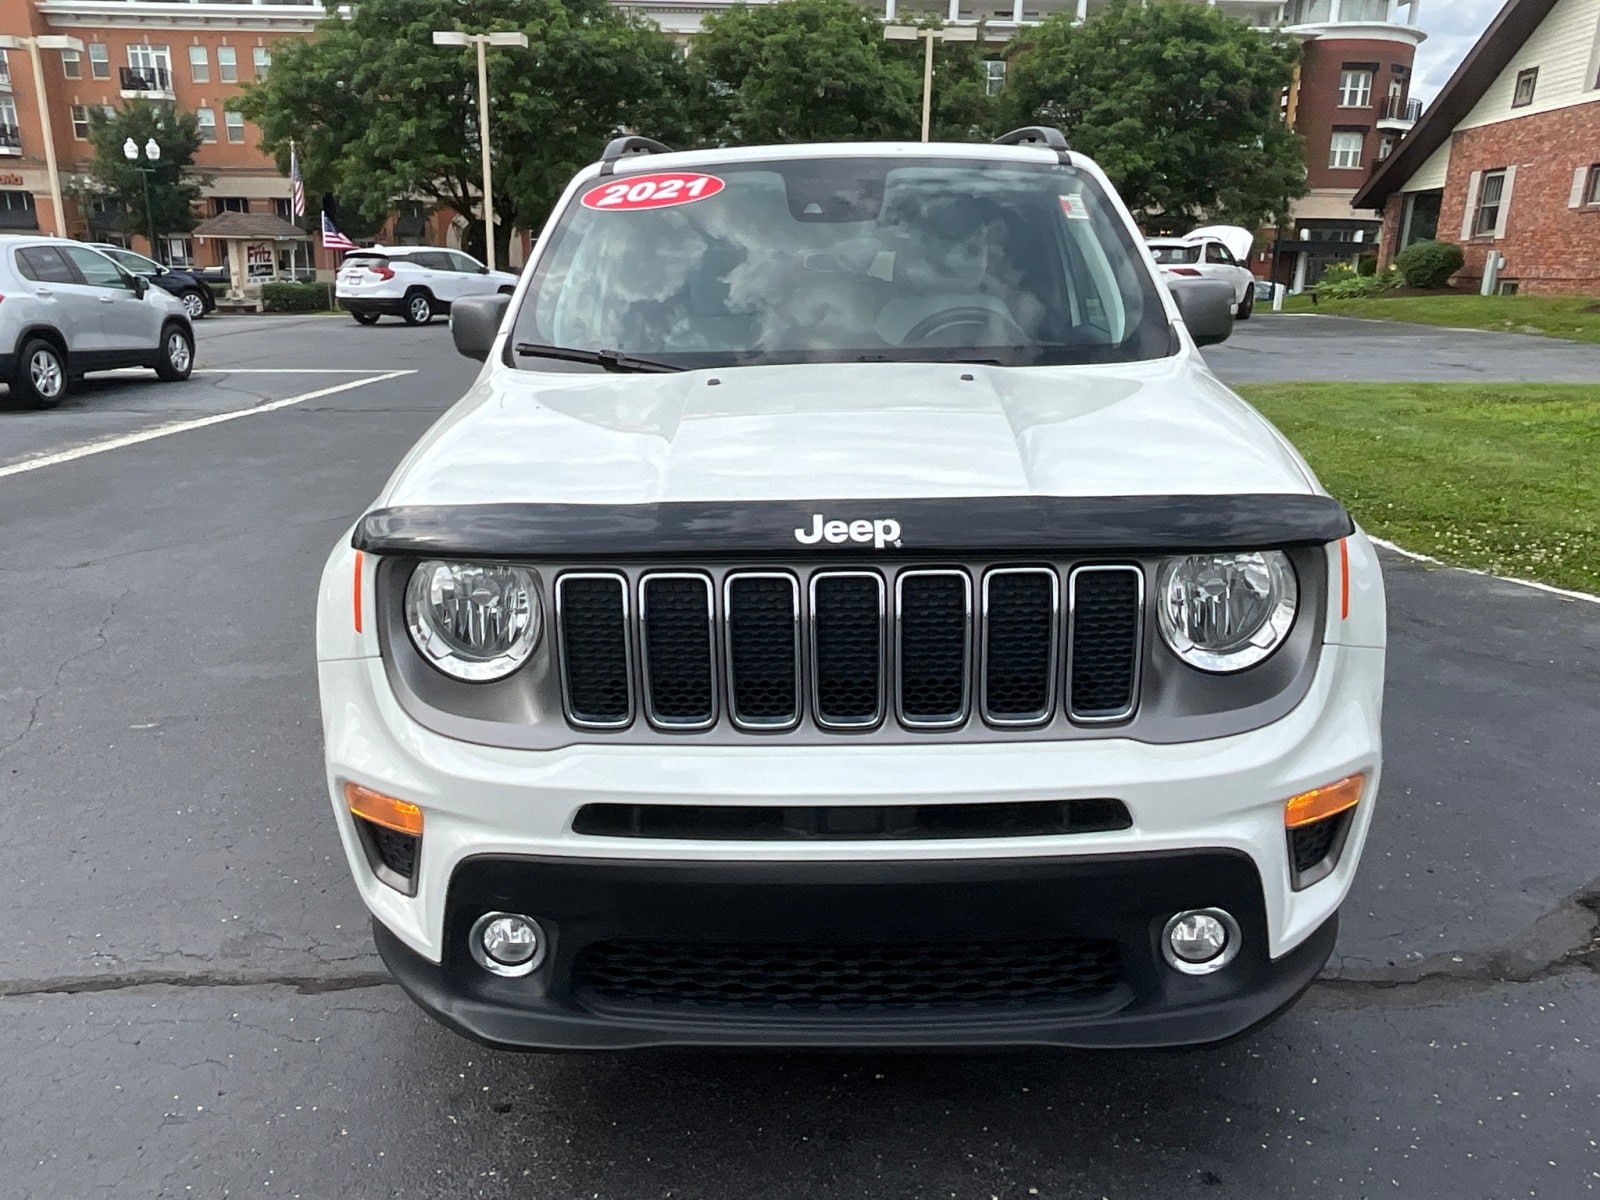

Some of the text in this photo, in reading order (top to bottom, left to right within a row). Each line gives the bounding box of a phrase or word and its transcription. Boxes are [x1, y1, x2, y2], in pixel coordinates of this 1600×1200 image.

[596, 177, 709, 207] 2021
[247, 245, 272, 263] Fritz
[794, 514, 903, 549] Jeep
